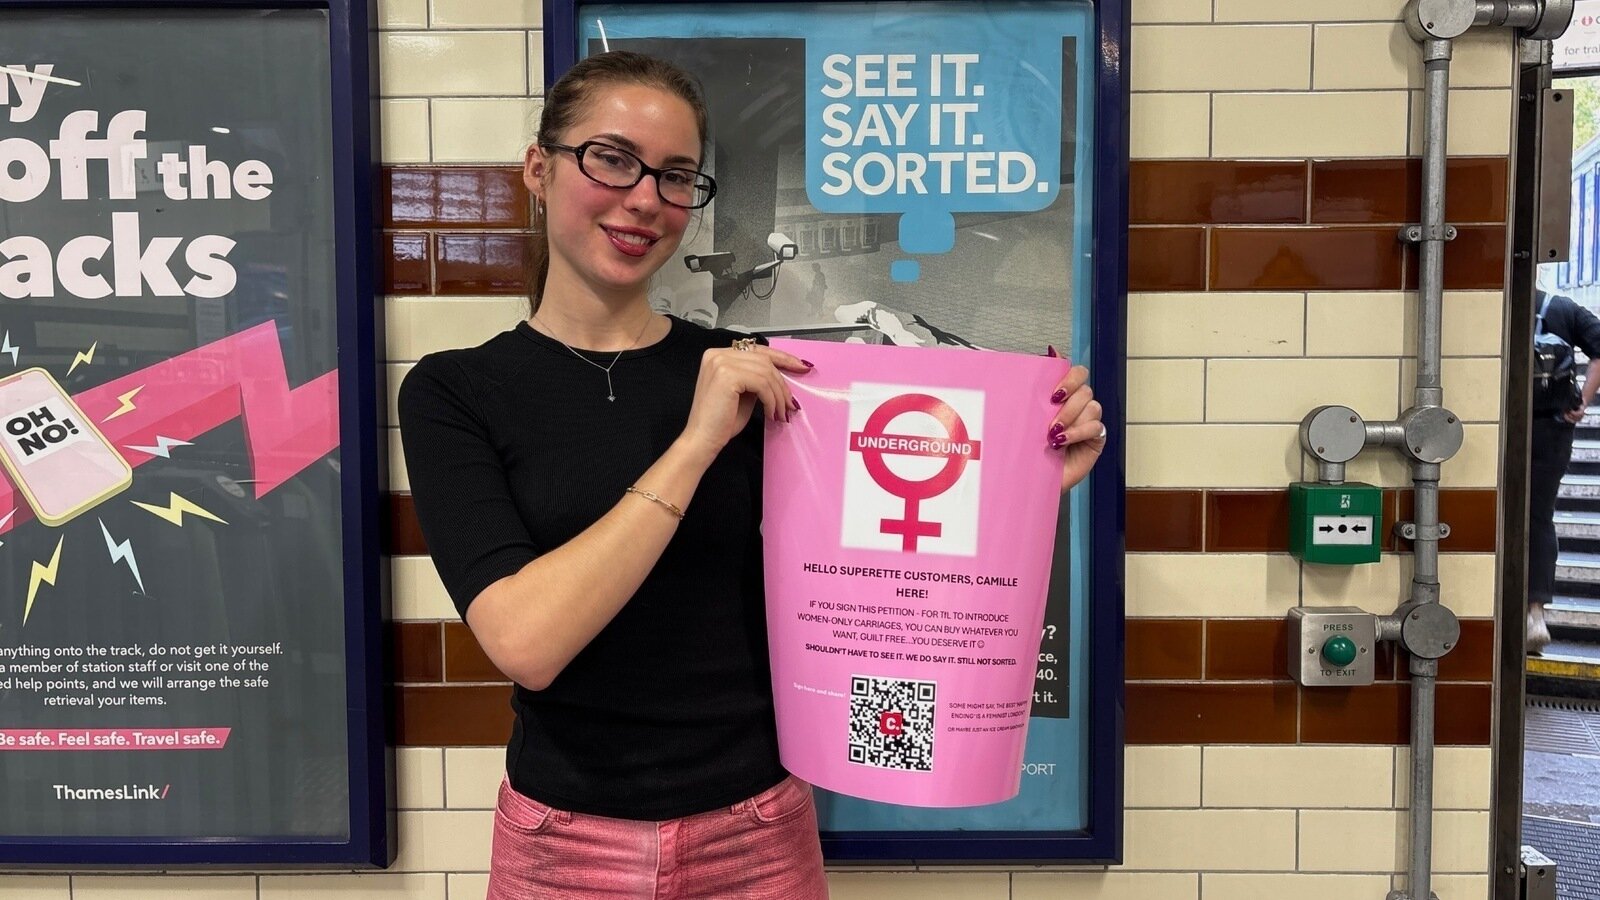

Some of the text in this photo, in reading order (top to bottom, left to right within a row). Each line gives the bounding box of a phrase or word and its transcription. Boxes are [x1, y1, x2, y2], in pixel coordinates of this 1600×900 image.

[820, 54, 984, 98] SEE IT.
[820, 103, 983, 147] SAY IT.
[0, 109, 274, 202] off the
[820, 151, 1049, 196] SORTED.
[6, 406, 56, 435] OH
[17, 418, 79, 456] NO!
[857, 436, 972, 455] UNDERGROUND
[803, 563, 1018, 587] HELLO SUPERETTE CUSTOMERS, CAMILLE
[896, 588, 928, 598] HERE!
[809, 600, 816, 608] IF
[818, 602, 834, 610] YOU
[836, 603, 856, 612] SIGN
[858, 605, 876, 614] THIS
[877, 606, 914, 617] PETITION
[921, 610, 938, 618] FOR
[953, 612, 964, 620] TO
[965, 613, 1009, 622] INTRODUCE
[797, 612, 1018, 637] WOMEN-ONLY CARRIAGES, YOU CAN BUY WHATEVER YOU
[832, 630, 858, 641] WANT,
[860, 633, 884, 642] GUILT
[931, 638, 968, 648] DESERVE
[54, 646, 83, 656] onto
[86, 644, 107, 656] the
[110, 643, 146, 657] track,
[149, 643, 166, 655] do
[170, 645, 191, 655] not
[194, 645, 216, 658] get
[220, 643, 228, 655] it
[231, 642, 283, 657] yourself.
[805, 643, 846, 655] SHOULDN'T
[847, 649, 868, 658] HAVE
[880, 652, 897, 660] SEE
[906, 654, 918, 662] WE
[9, 661, 62, 673] member
[66, 660, 79, 673] of
[82, 661, 125, 672] station
[128, 660, 157, 672] staff
[160, 663, 173, 672] or
[177, 660, 201, 672] visit
[205, 662, 229, 671] one
[233, 659, 246, 671] of
[249, 659, 269, 671] the
[16, 677, 43, 692] help
[47, 678, 89, 690] points,
[93, 677, 116, 689] and
[120, 680, 139, 689] we
[142, 677, 163, 689] will
[167, 679, 216, 691] arrange
[220, 676, 240, 688] the
[244, 675, 269, 688] safe
[44, 693, 167, 708] retrieval your items.
[1043, 691, 1057, 703] it.
[886, 717, 900, 730] C.
[0, 731, 220, 745] Be safe. Feel safe. Travel safe.
